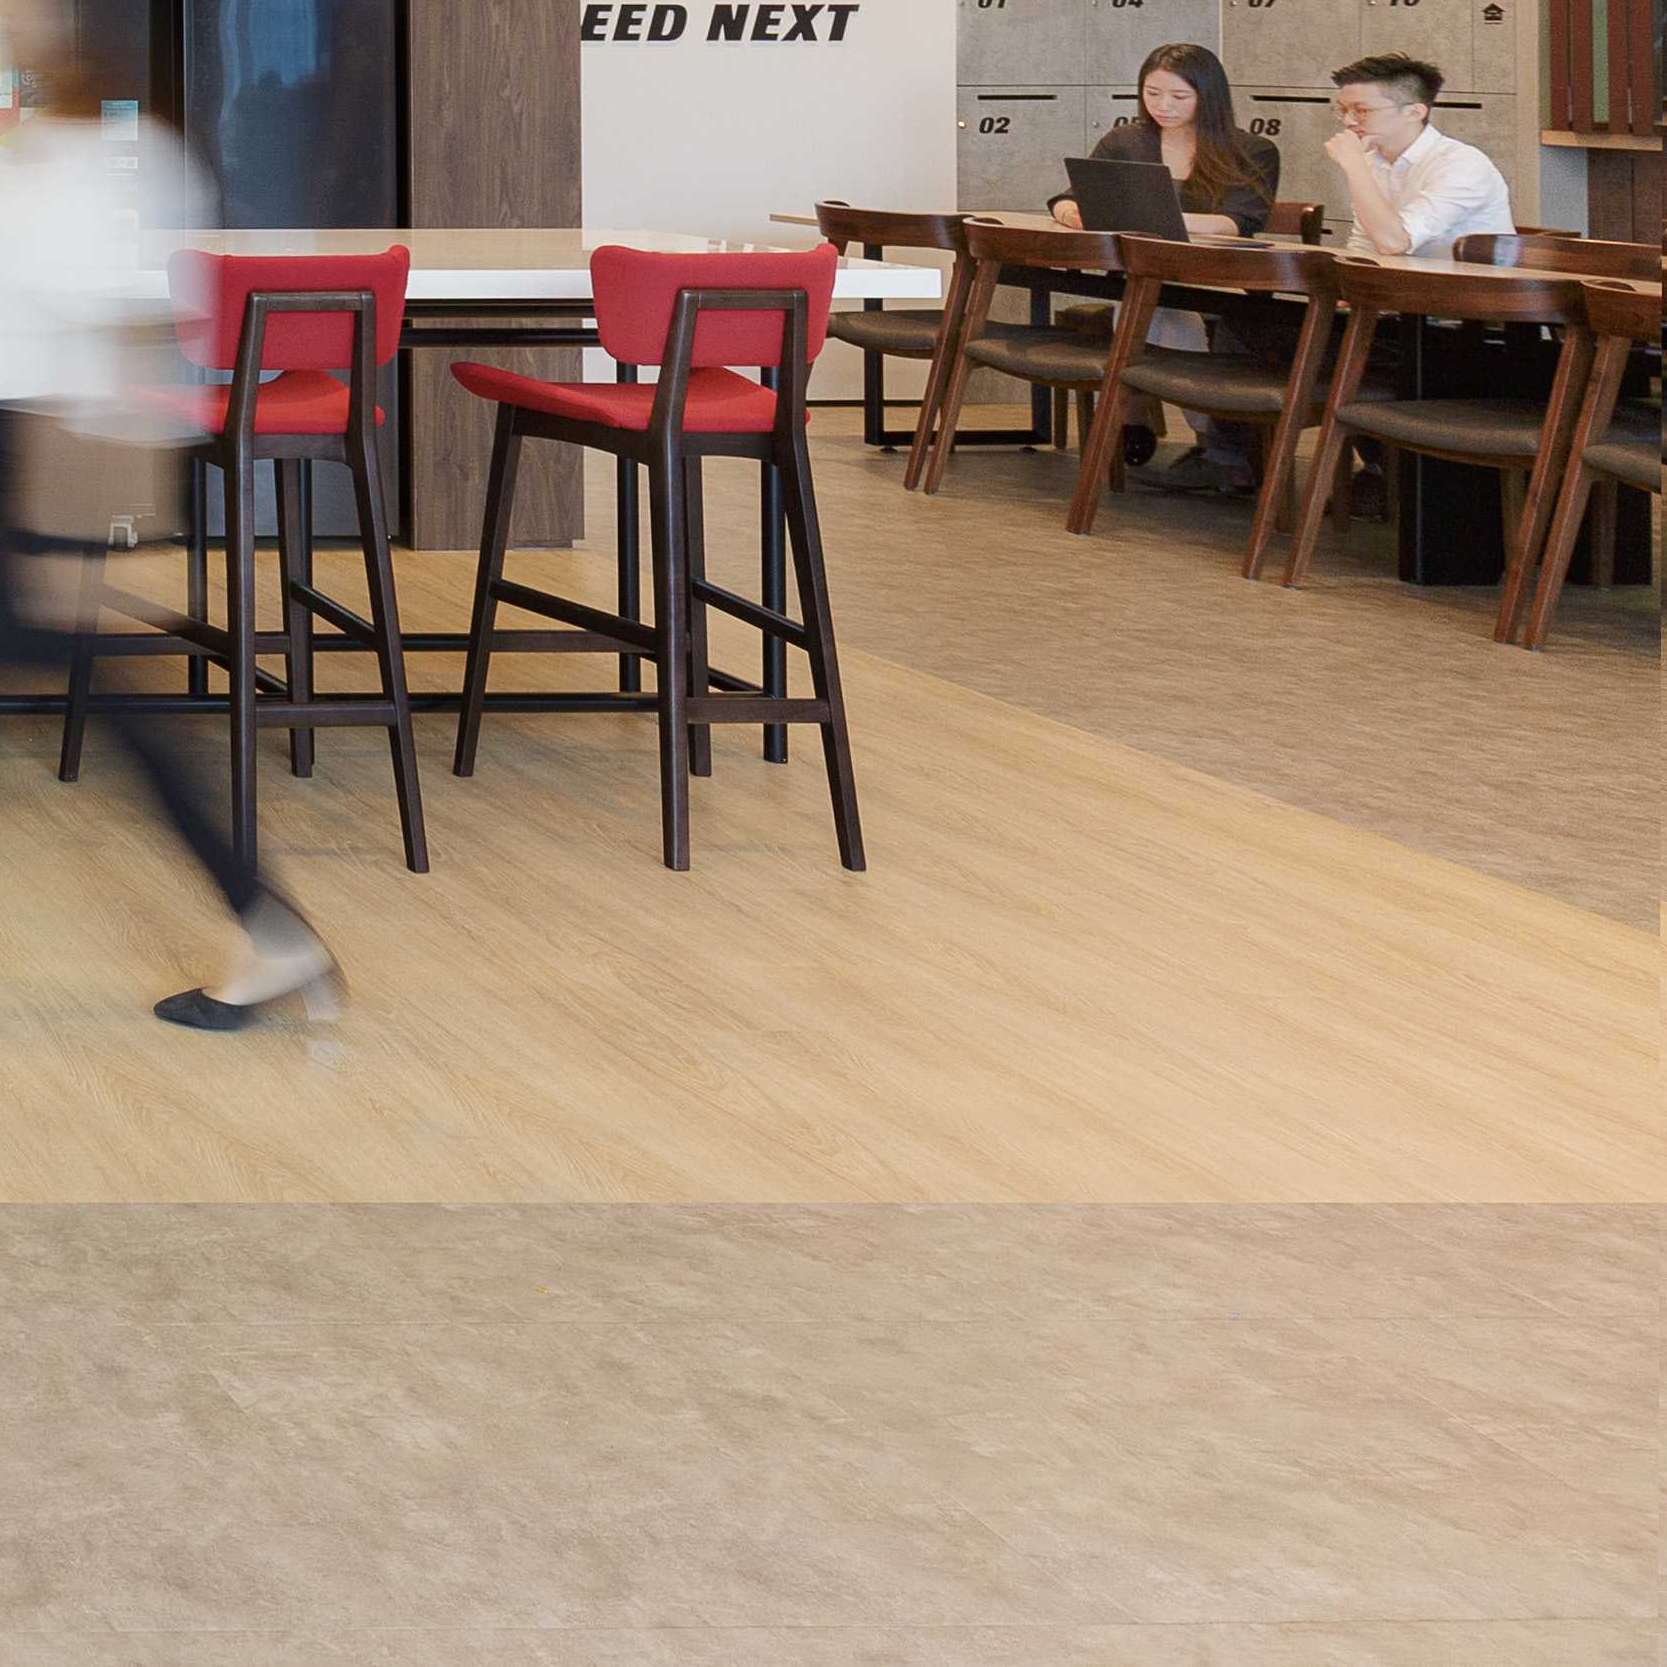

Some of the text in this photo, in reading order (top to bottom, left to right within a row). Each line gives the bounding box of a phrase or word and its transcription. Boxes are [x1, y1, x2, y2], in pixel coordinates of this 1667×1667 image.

[706, 4, 860, 42] NEXT
[979, 116, 1011, 134] 02
[1249, 117, 1281, 136] 08
